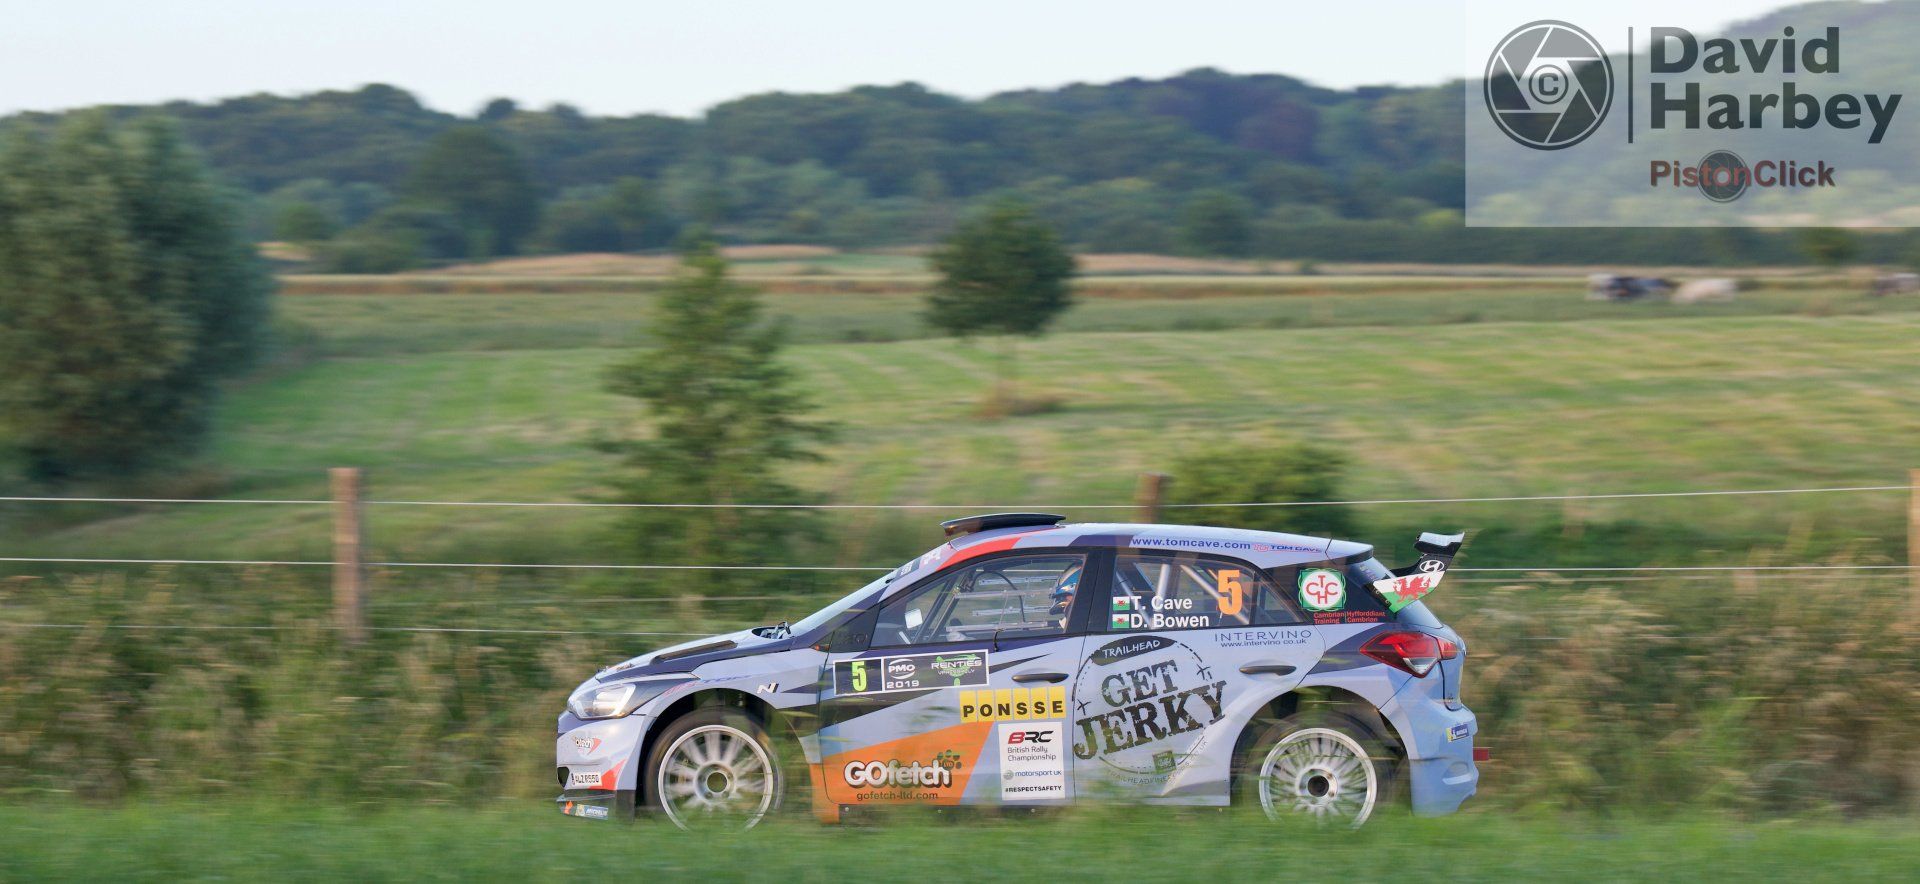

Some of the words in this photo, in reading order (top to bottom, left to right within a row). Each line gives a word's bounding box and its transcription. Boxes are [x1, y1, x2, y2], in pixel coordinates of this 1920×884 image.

[1132, 538, 1250, 550] www.tomcave.com
[1217, 569, 1243, 615] 5
[1130, 596, 1146, 610] T.
[1151, 596, 1192, 610] Cave
[1131, 614, 1148, 629] D.
[1153, 613, 1209, 629] Bowen
[1314, 611, 1344, 619] Cambrian
[1215, 630, 1312, 642] INTERVINO
[1104, 639, 1160, 659] TRAILHEAD
[888, 664, 915, 673] PMO
[931, 660, 982, 669] RENTIES
[852, 661, 867, 691] 5
[886, 680, 919, 689] 2019
[1101, 660, 1178, 707] GET
[963, 700, 1064, 718] PONSSE
[1073, 680, 1227, 760] JERKY
[1008, 731, 1054, 744] BRC
[1008, 746, 1030, 754] British
[1031, 745, 1048, 754] Rally
[1008, 754, 1056, 762] Championship
[843, 759, 951, 788] GOfetch
[1005, 785, 1062, 793] #RESPECTSAFETY
[857, 790, 938, 801] gofetch-ltd.com
